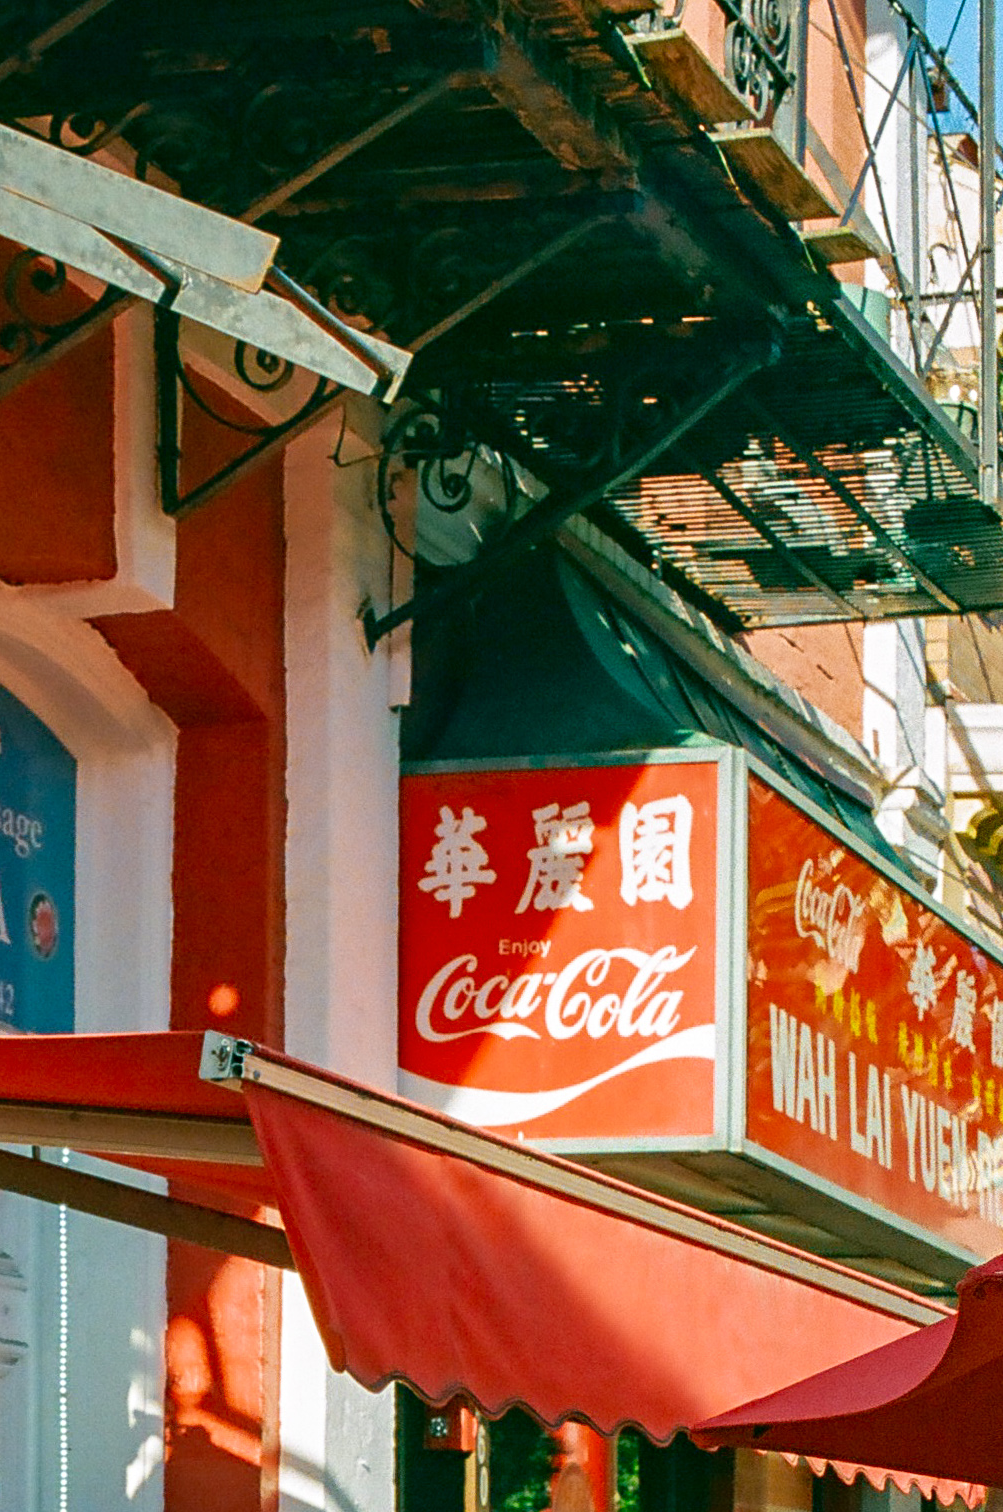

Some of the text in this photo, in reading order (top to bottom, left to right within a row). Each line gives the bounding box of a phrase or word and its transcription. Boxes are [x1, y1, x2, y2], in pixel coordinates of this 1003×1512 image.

[418, 795, 693, 918] 華麗園
[415, 945, 697, 1043] Coca-Cola
[498, 938, 553, 959] Enjoy
[768, 1003, 837, 1140] WAH
[848, 1051, 893, 1170] LAI
[901, 1083, 968, 1211] YUEN
